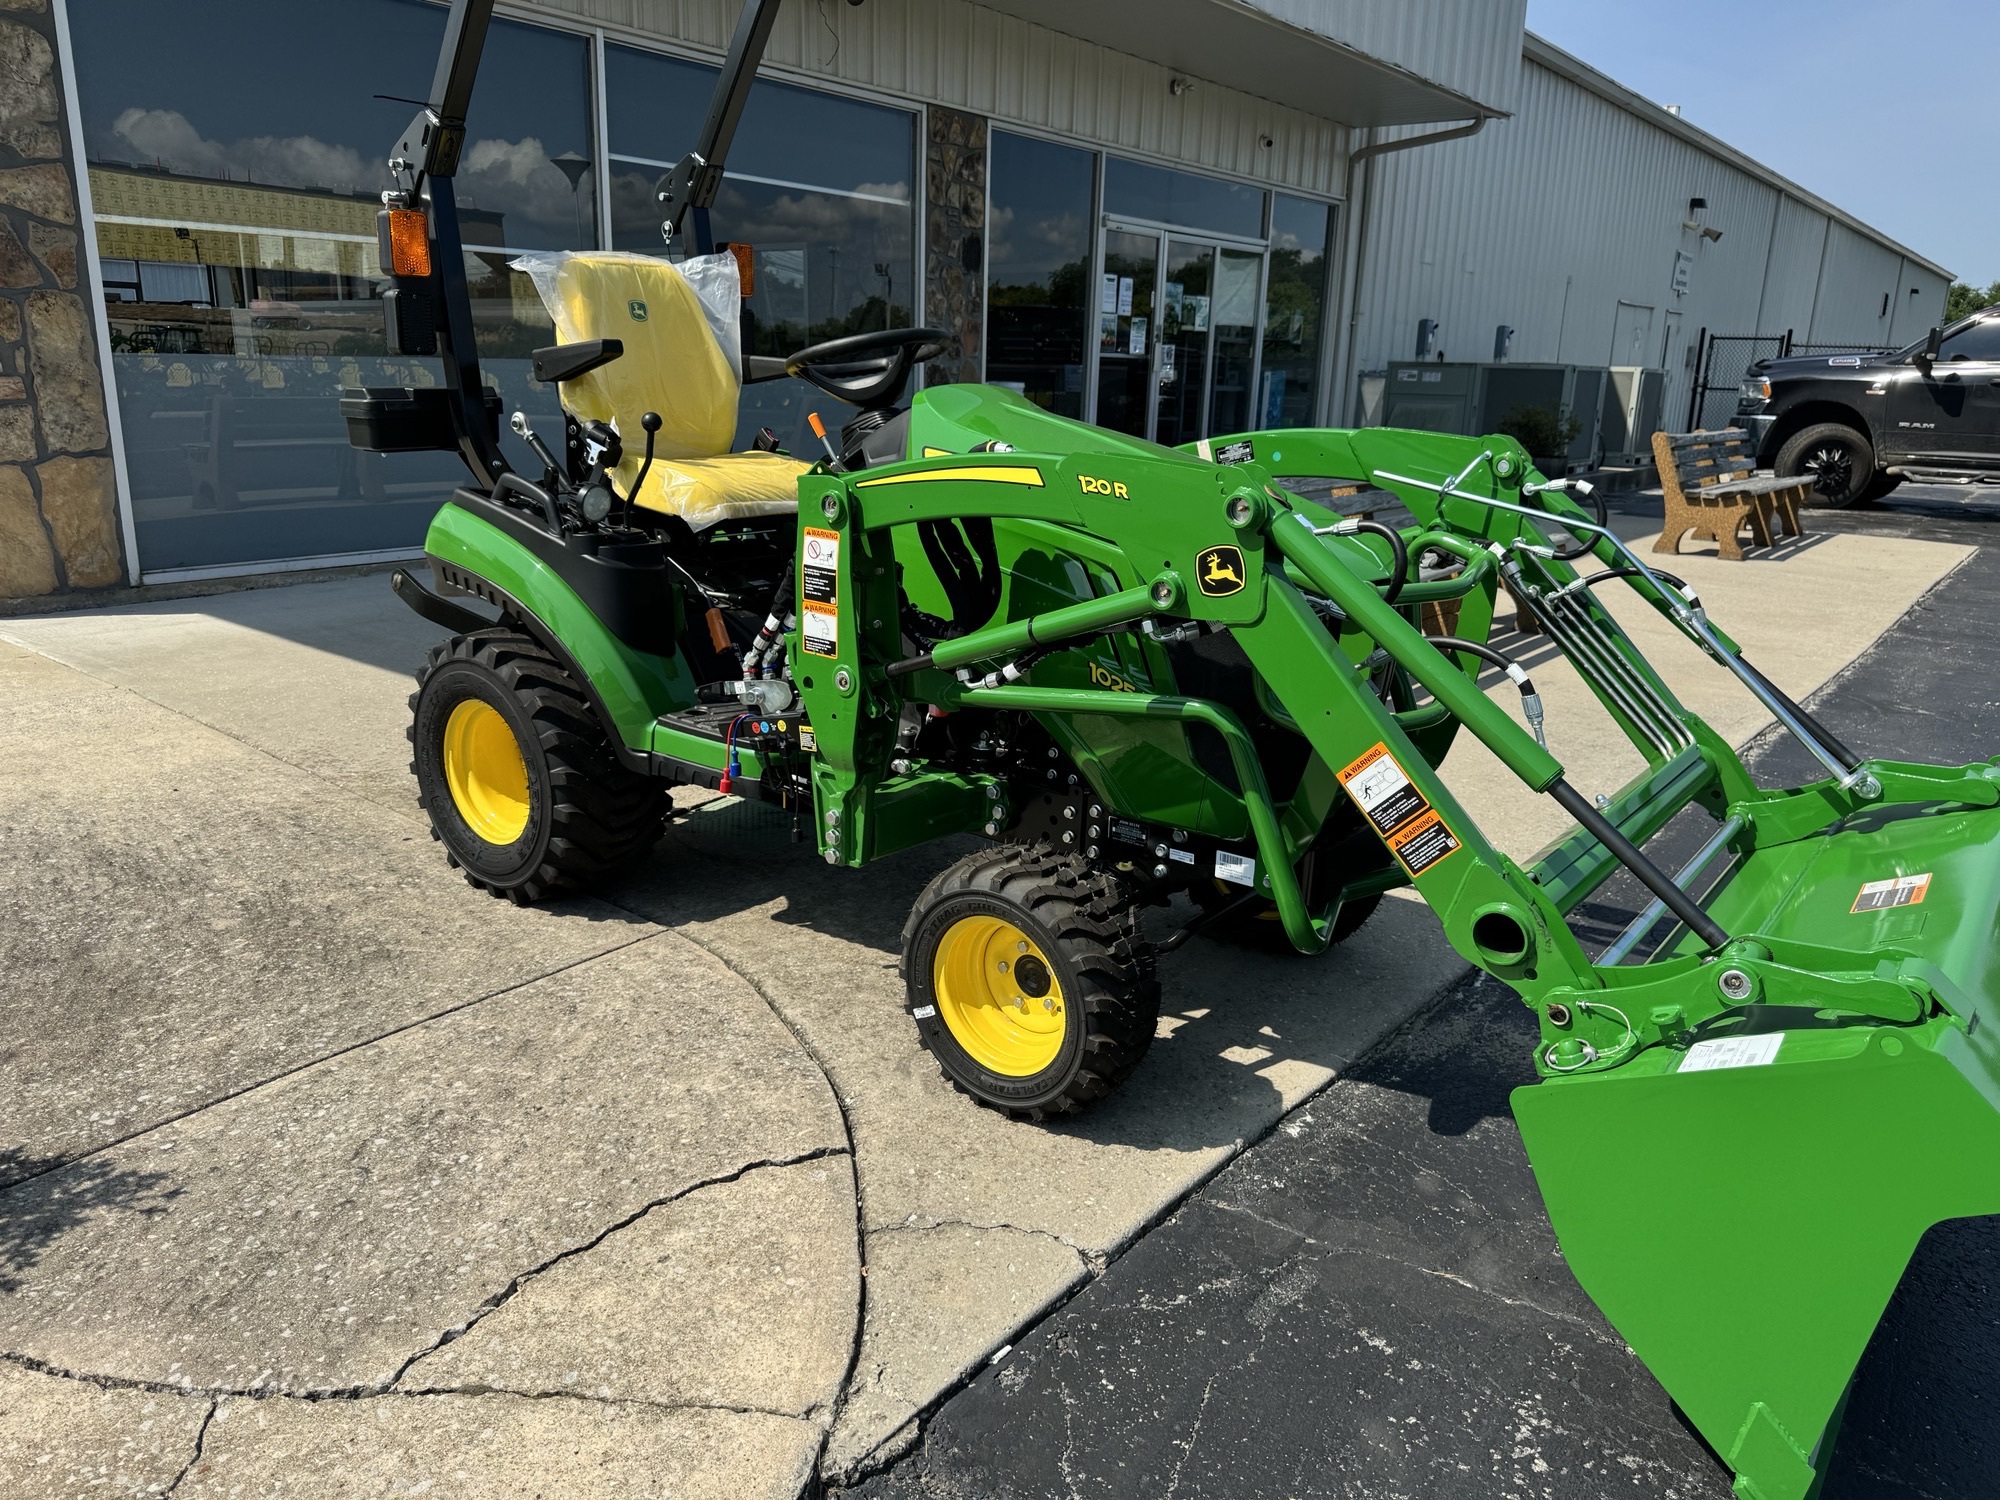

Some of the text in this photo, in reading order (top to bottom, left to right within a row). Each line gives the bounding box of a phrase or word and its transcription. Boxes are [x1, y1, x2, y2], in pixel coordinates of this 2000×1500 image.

[1898, 421, 1935, 429] RAM
[812, 530, 838, 540] WARNING
[810, 604, 836, 615] WARNING
[1350, 748, 1382, 773] WARNING
[1401, 815, 1434, 840] WARNING
